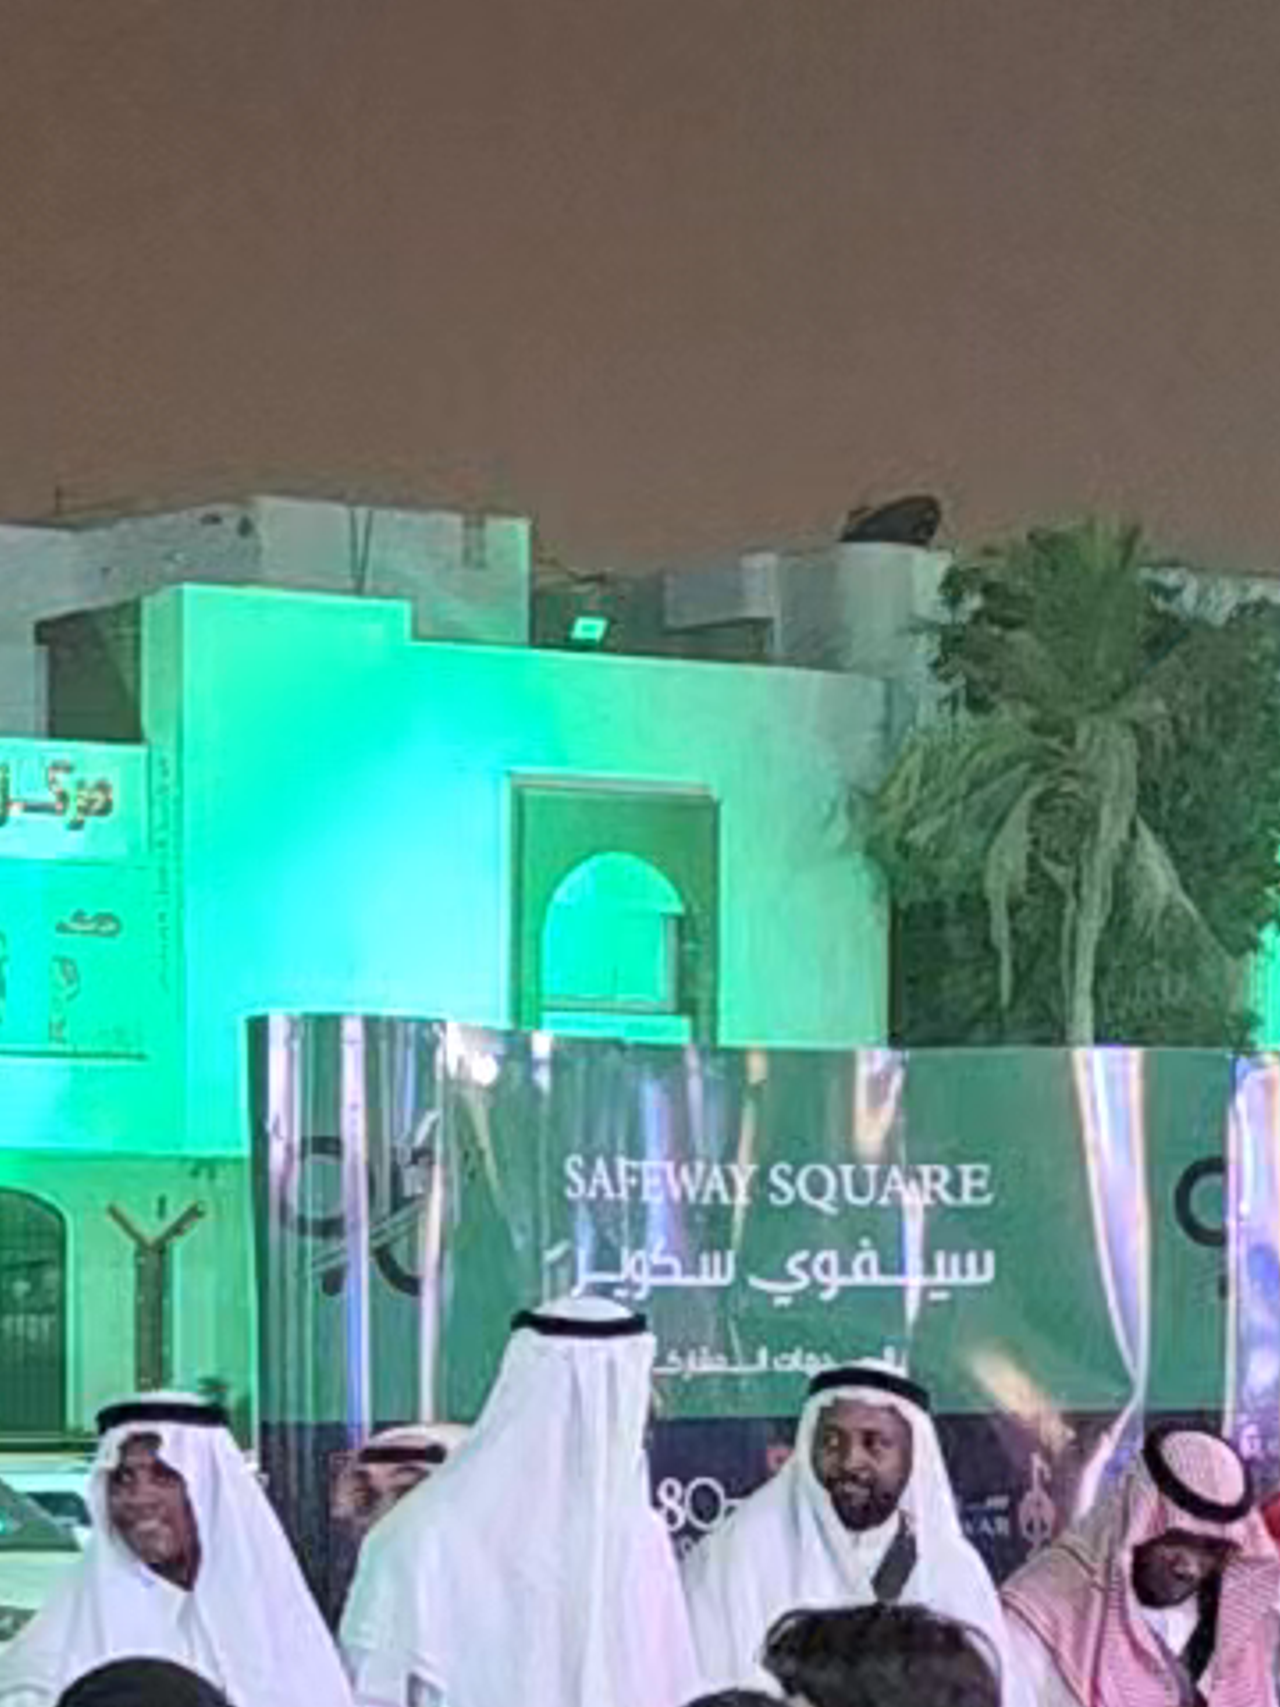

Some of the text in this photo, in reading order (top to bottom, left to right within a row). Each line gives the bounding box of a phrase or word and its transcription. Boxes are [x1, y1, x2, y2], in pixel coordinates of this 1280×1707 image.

[564, 1154, 994, 1215] SAFEWAY SQUARE
[747, 1236, 996, 1307] سيفوي
